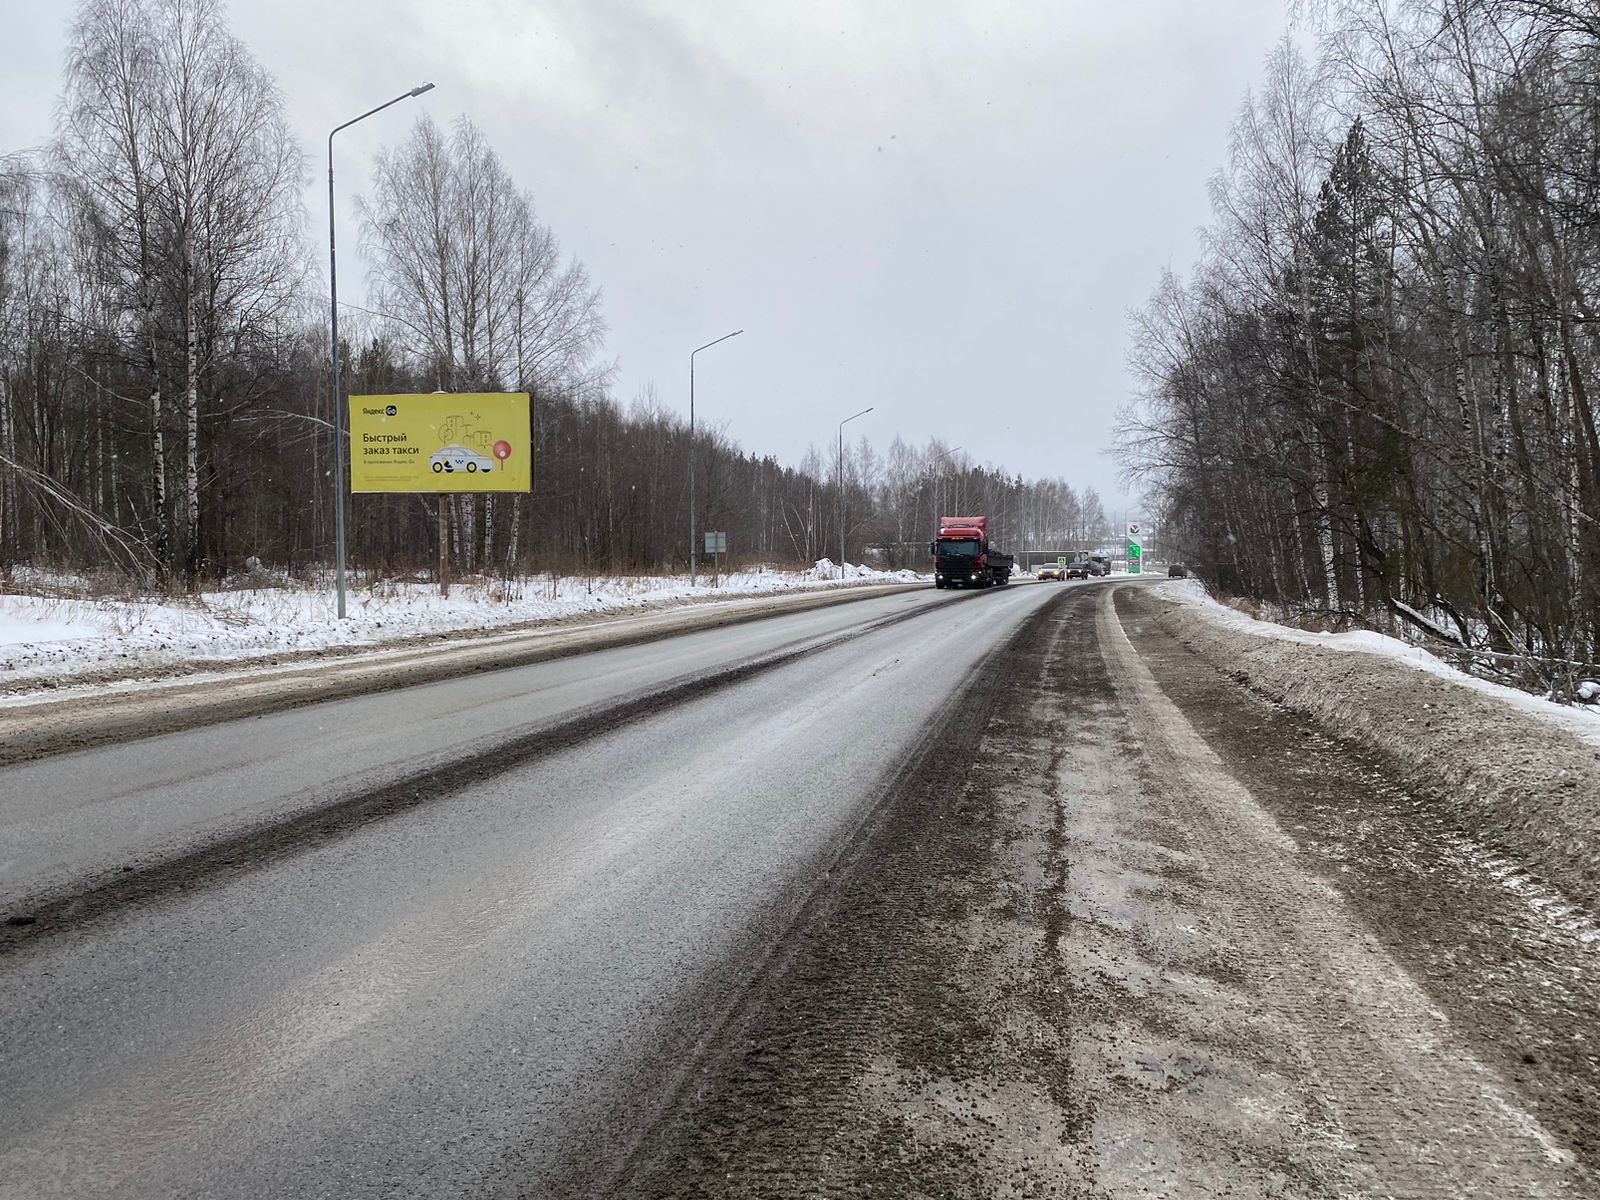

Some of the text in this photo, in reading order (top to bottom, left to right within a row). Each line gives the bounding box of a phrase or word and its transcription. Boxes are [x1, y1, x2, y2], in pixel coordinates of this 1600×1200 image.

[387, 407, 396, 415] Go
[363, 433, 407, 443] Быстрый
[363, 447, 419, 455] заказ такси
